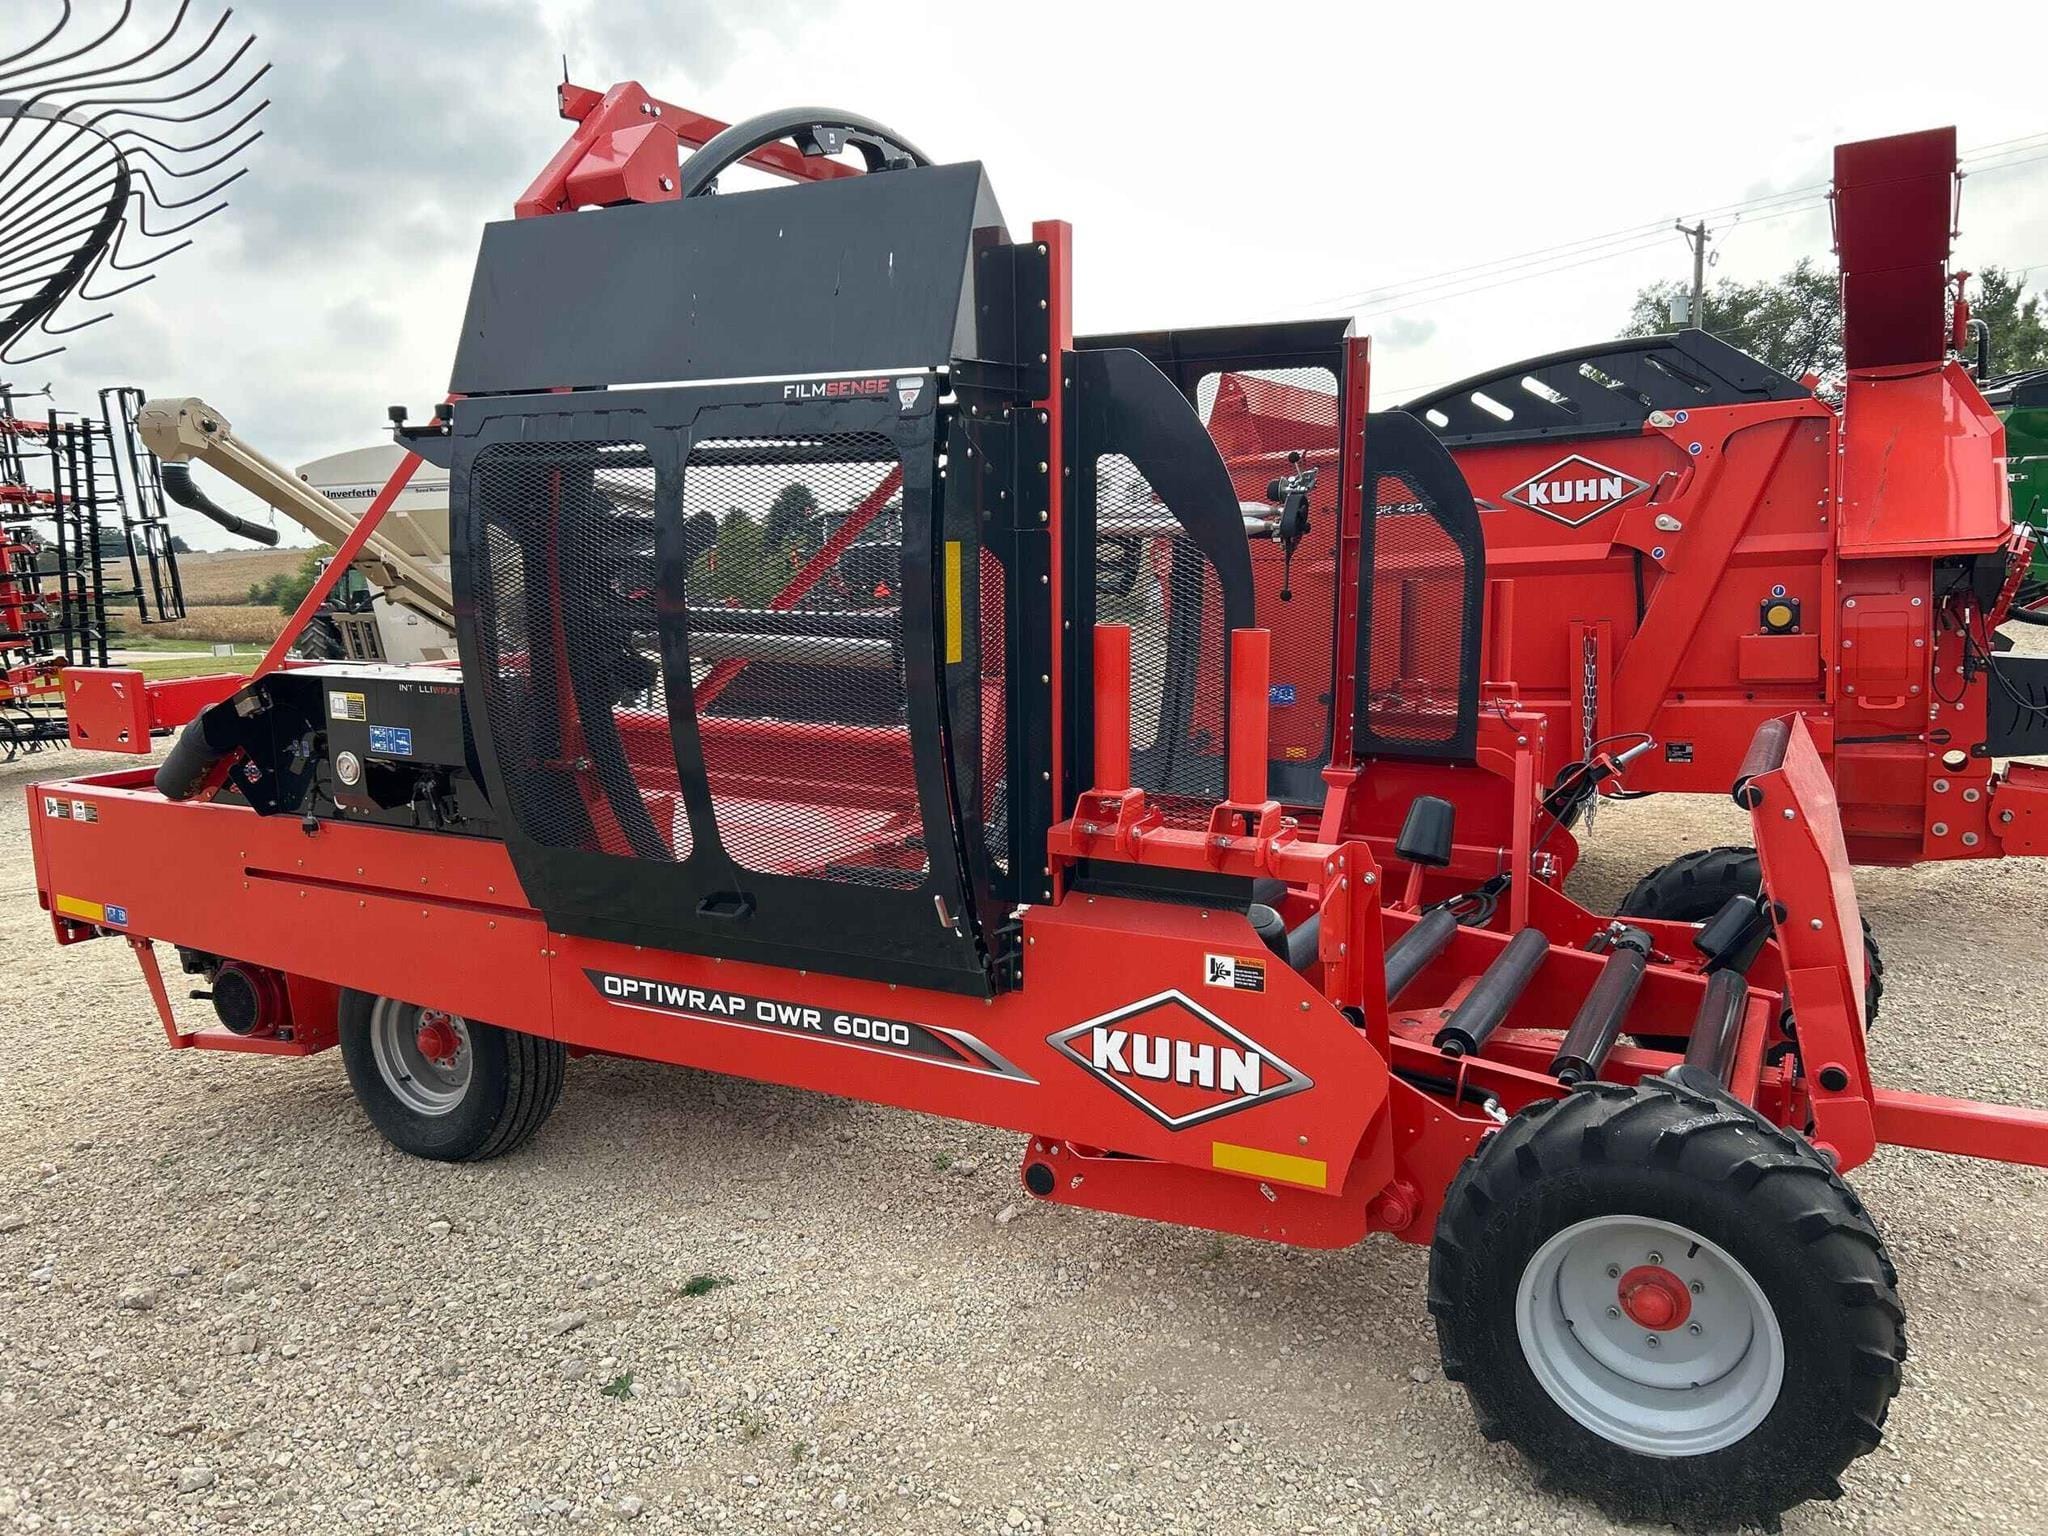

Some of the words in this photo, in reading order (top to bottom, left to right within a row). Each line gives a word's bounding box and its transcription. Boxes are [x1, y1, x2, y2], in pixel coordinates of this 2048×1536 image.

[783, 378, 891, 399] FILMSENSE
[322, 487, 378, 499] Unverferth
[1527, 476, 1623, 506] KUHN
[603, 974, 746, 1016] OPTIWRAP
[756, 1001, 823, 1031] OWR
[833, 1014, 910, 1047] 6000
[1092, 1026, 1261, 1097] KUHN
